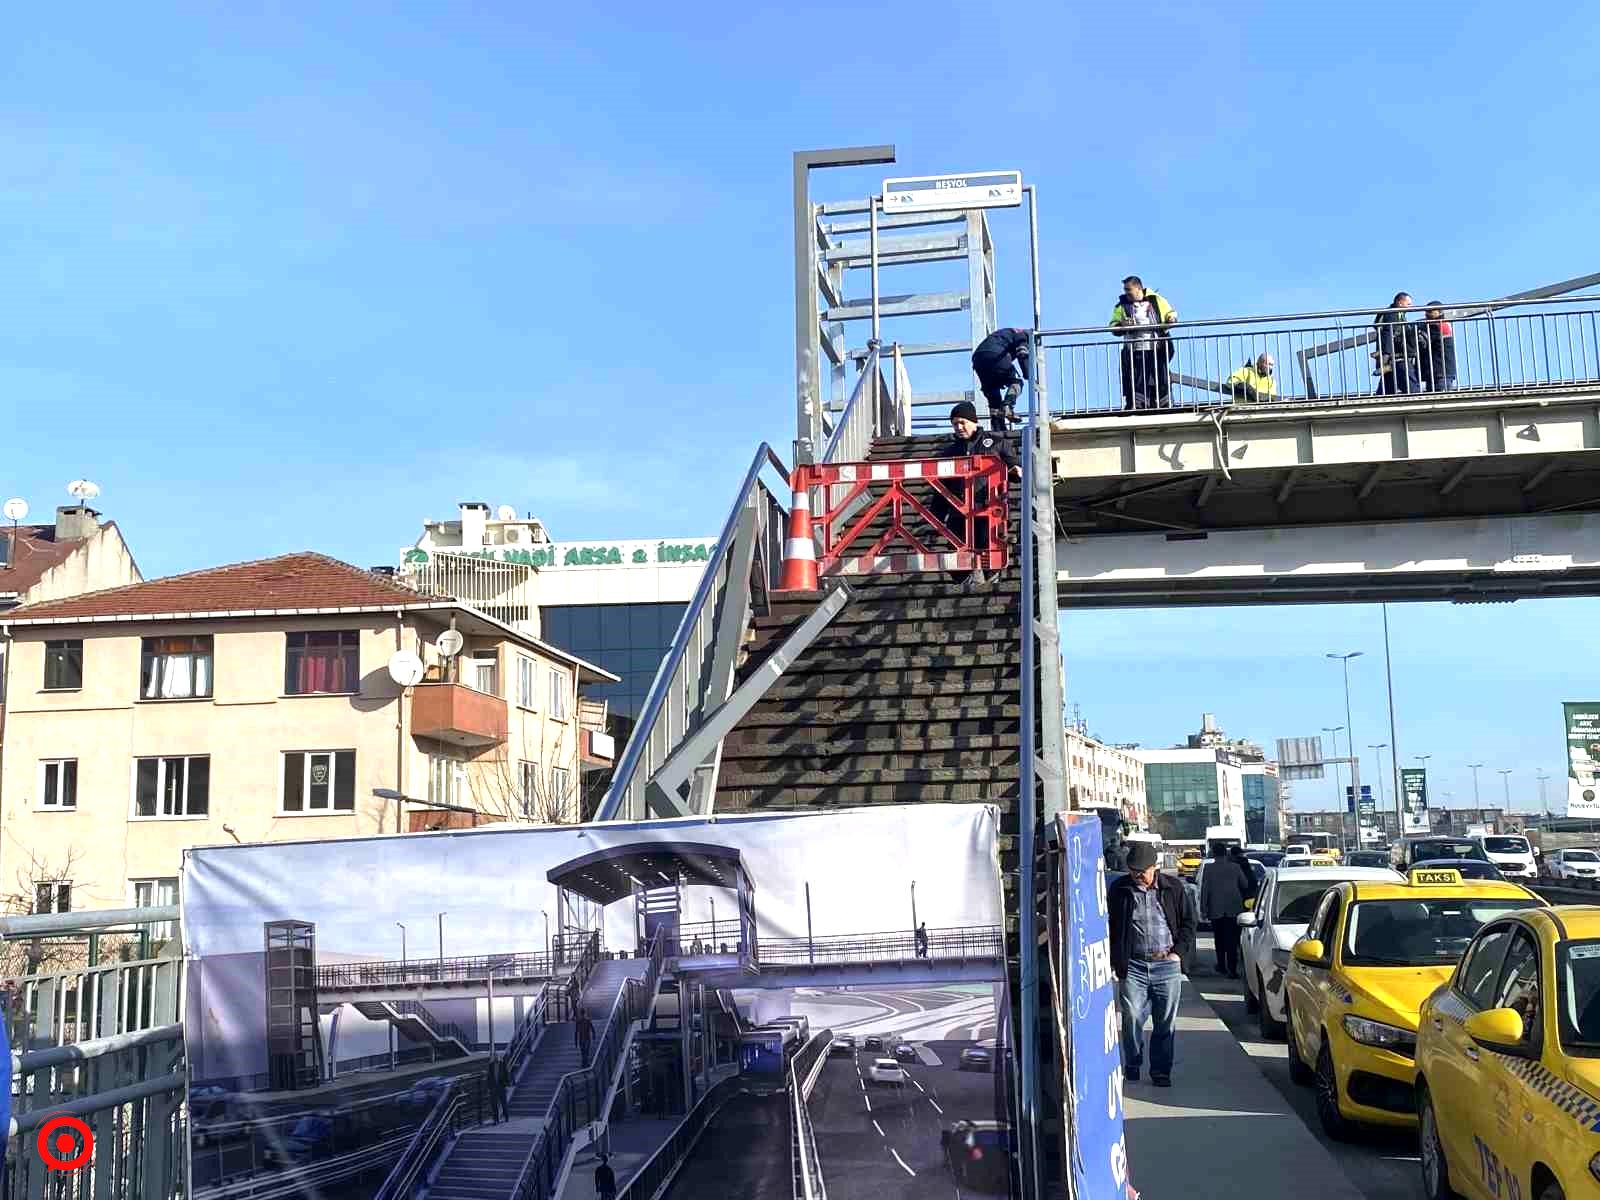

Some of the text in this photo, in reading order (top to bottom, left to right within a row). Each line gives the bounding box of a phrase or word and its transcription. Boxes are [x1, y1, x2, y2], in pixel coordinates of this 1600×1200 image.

[563, 547, 623, 566] ARSA
[632, 549, 648, 564] &
[657, 541, 720, 564] İNŞA
